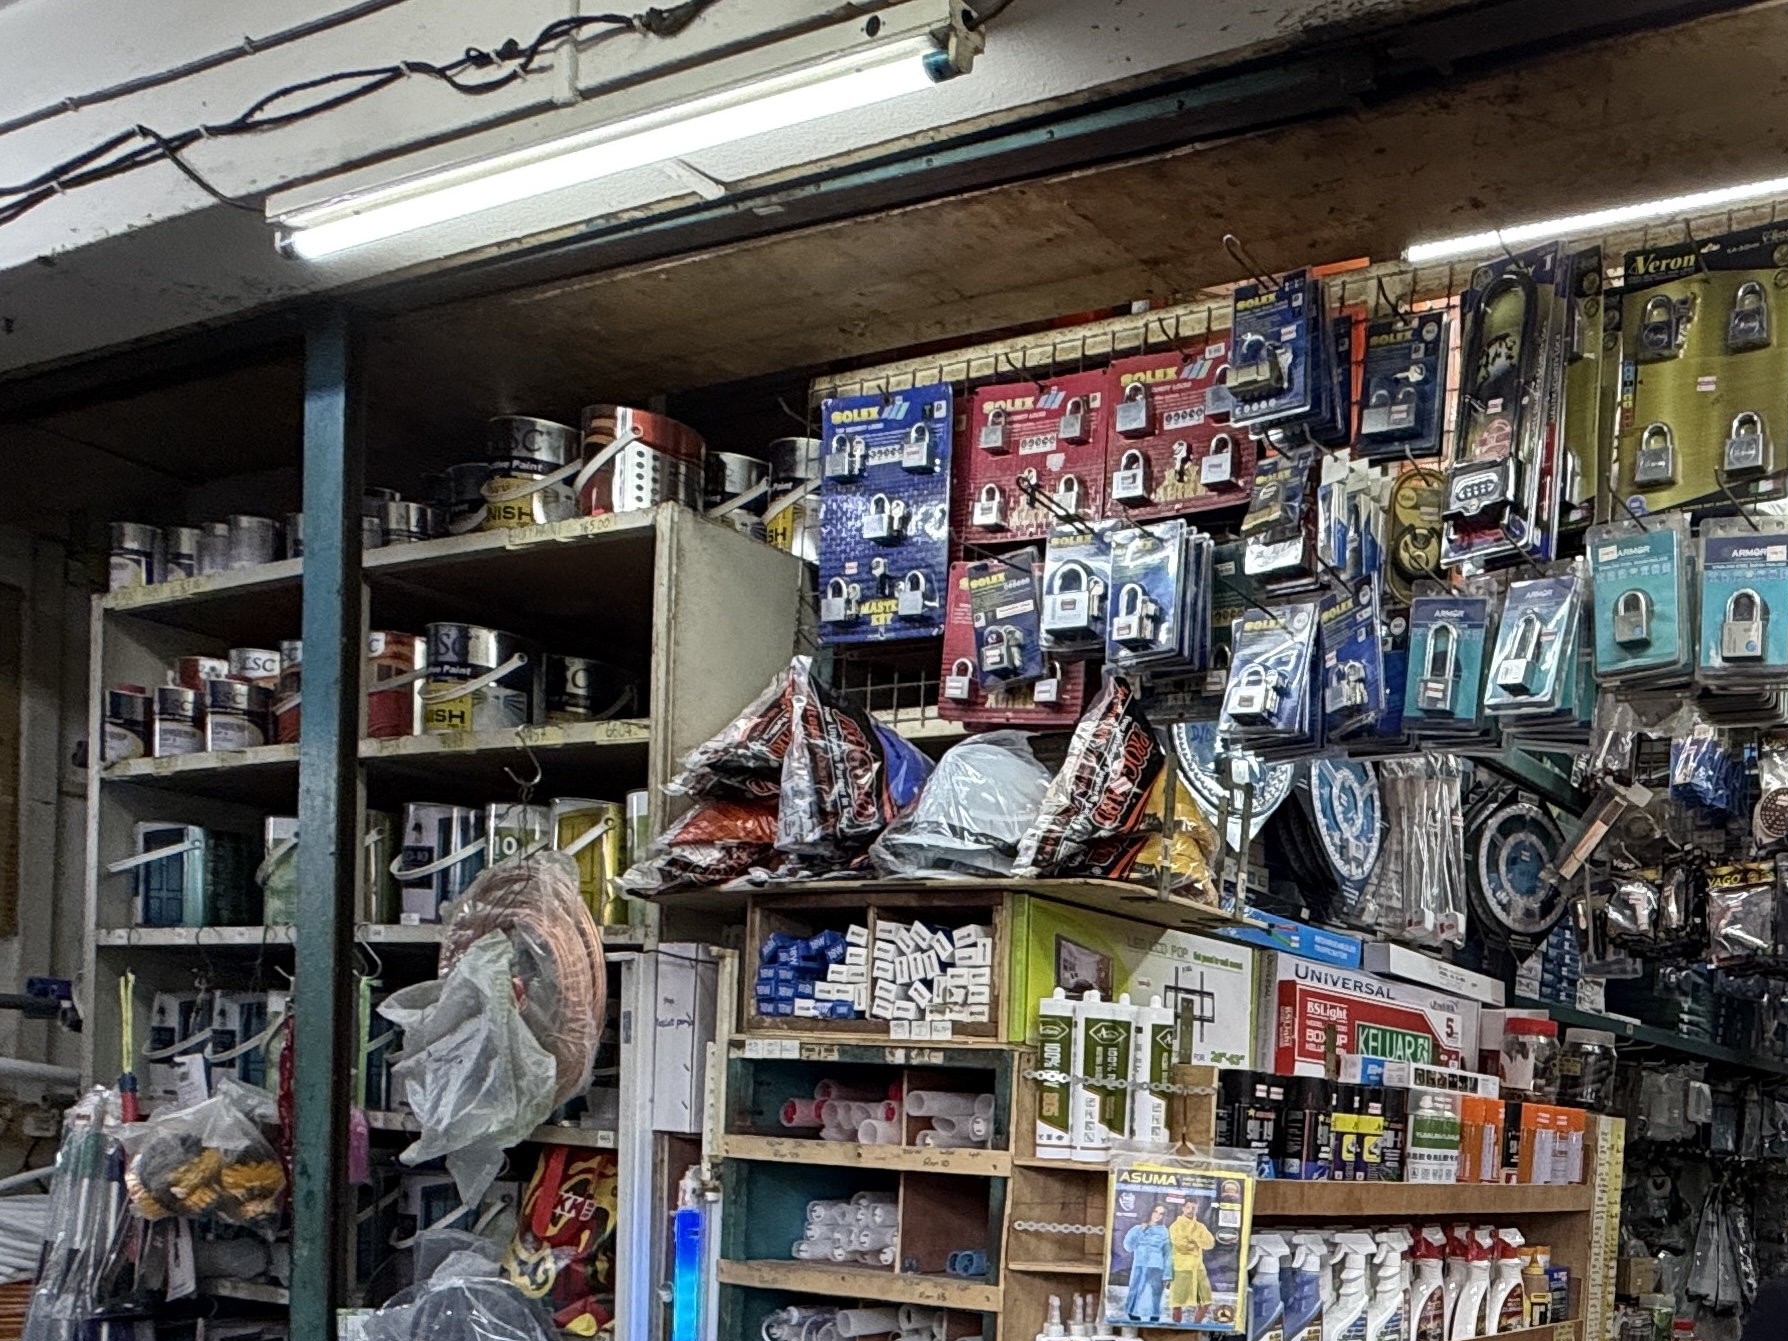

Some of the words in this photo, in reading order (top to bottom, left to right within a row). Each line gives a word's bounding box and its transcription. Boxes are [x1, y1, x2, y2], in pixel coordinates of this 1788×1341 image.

[1628, 252, 1695, 276] Veron
[1120, 367, 1178, 386] SOLEX
[983, 396, 1035, 414] SOLEX
[831, 406, 880, 424] SOLEX
[512, 459, 544, 472] Paint
[860, 600, 898, 614] MASTE
[1322, 598, 1354, 623] SOLEX
[1434, 609, 1465, 619] ARMOR
[1244, 616, 1285, 632] SOLEX
[443, 664, 472, 676] Paint
[1706, 874, 1742, 888] VAGO
[1295, 963, 1397, 1000] UNIVERSAL
[1306, 1001, 1348, 1021] BSLight
[1306, 1028, 1326, 1042] BOX
[1445, 1017, 1456, 1039] 5
[1120, 1172, 1177, 1186] ASUMA
